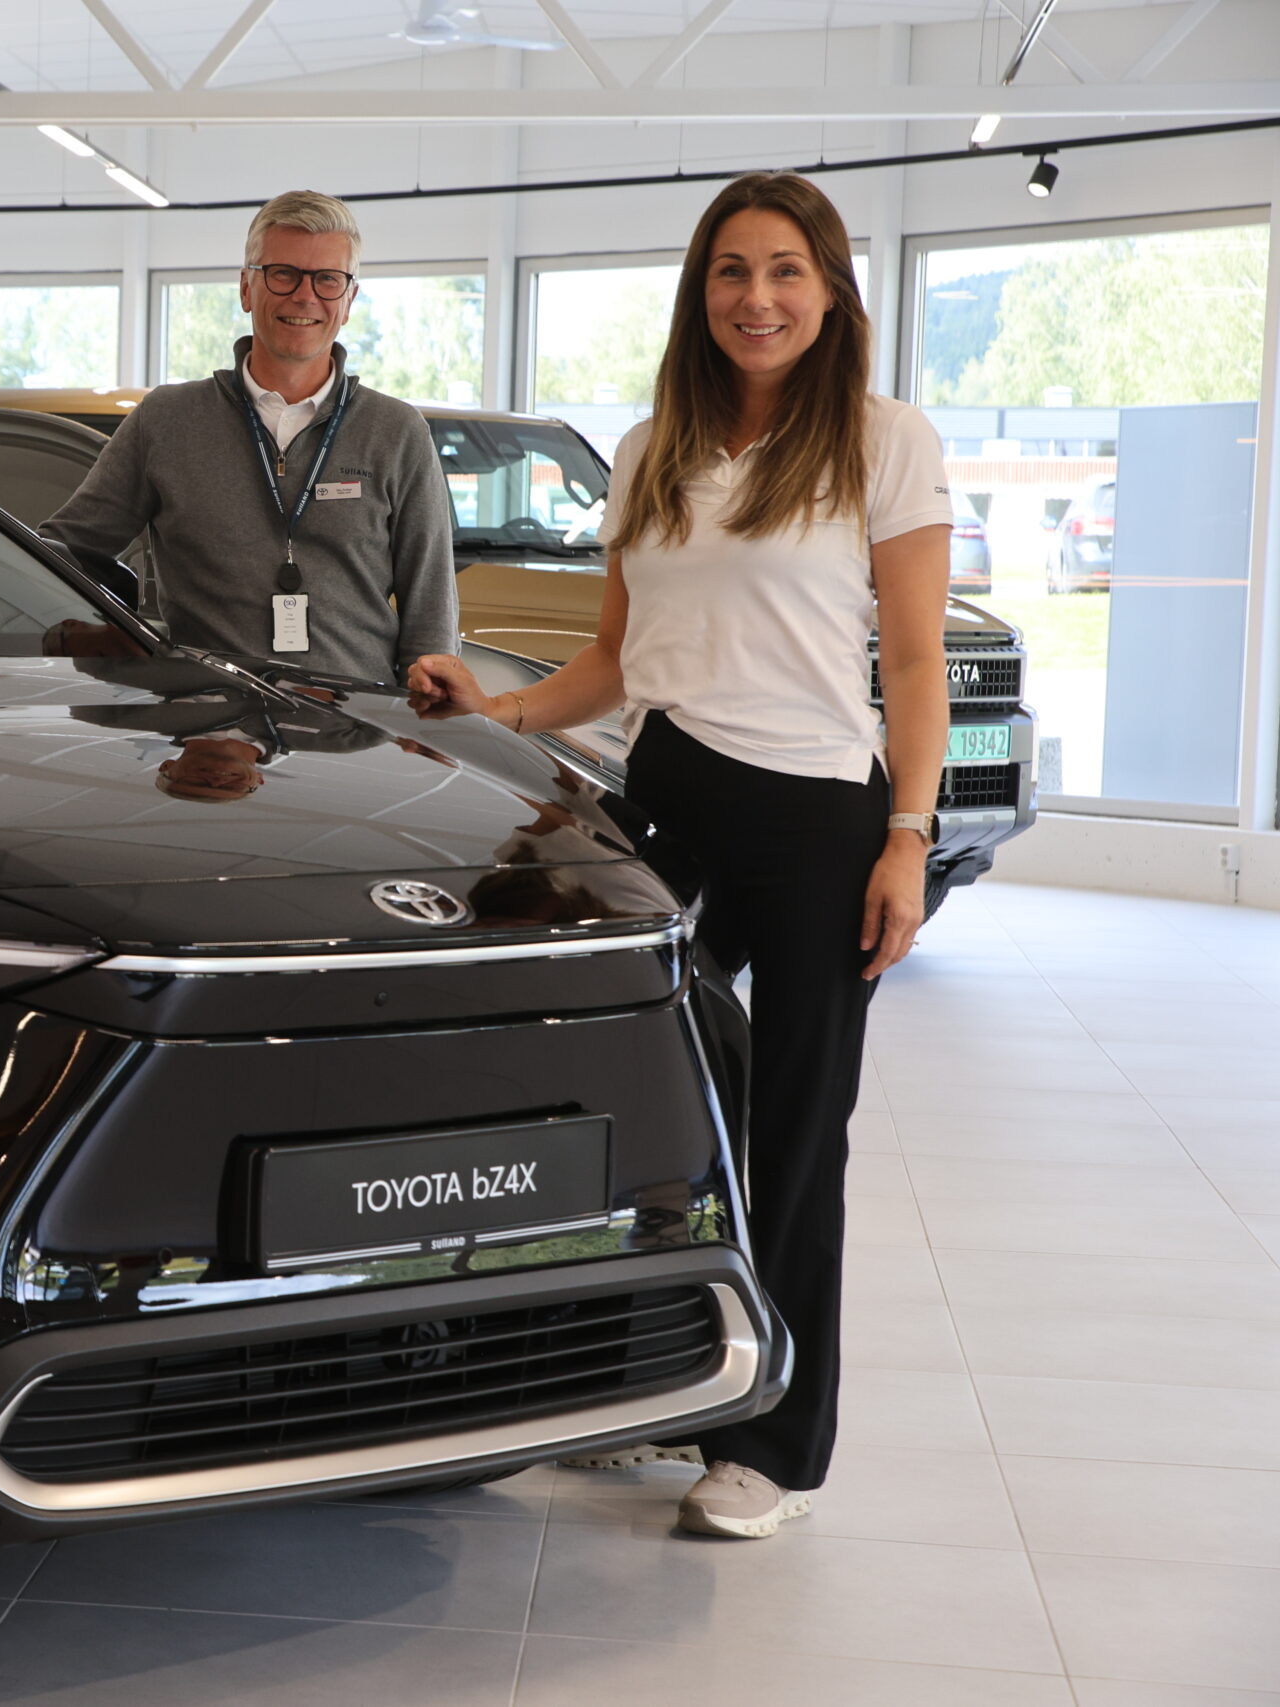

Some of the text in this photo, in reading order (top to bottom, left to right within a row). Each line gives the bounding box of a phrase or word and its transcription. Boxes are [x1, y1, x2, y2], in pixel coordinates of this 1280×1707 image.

[961, 729, 1007, 757] 19342
[352, 1161, 537, 1214] TOYOTA bZ4X
